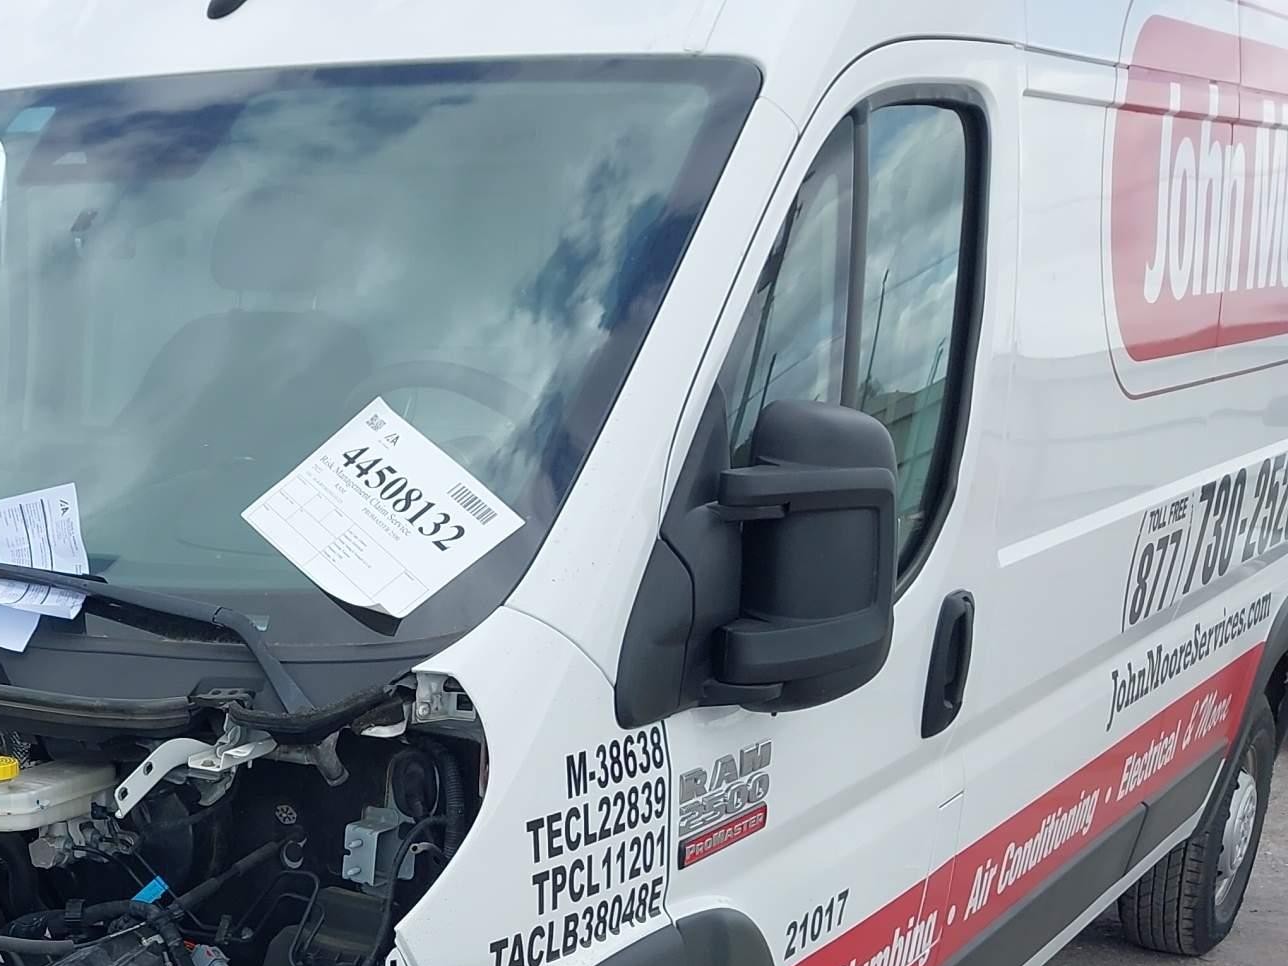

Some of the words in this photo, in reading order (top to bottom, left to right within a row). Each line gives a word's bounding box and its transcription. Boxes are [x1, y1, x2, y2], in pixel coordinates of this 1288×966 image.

[1143, 82, 1246, 304] John
[319, 454, 335, 471] Risk
[369, 495, 390, 518] Claim
[386, 513, 412, 537] Service
[341, 446, 466, 552] 44508132
[1148, 502, 1168, 535] TOLL
[1167, 497, 1189, 525] FREE
[1106, 592, 1272, 732] JohnMooreServices.com
[566, 726, 664, 799] M-38638
[678, 771, 770, 838] 2500
[679, 738, 772, 806] RAM
[526, 776, 667, 864] TECL22839
[963, 858, 997, 921] Air
[996, 788, 1101, 895] Conditioning
[1116, 719, 1183, 801] Electrical
[532, 825, 666, 916] TPCL11201
[783, 888, 850, 961] 21017
